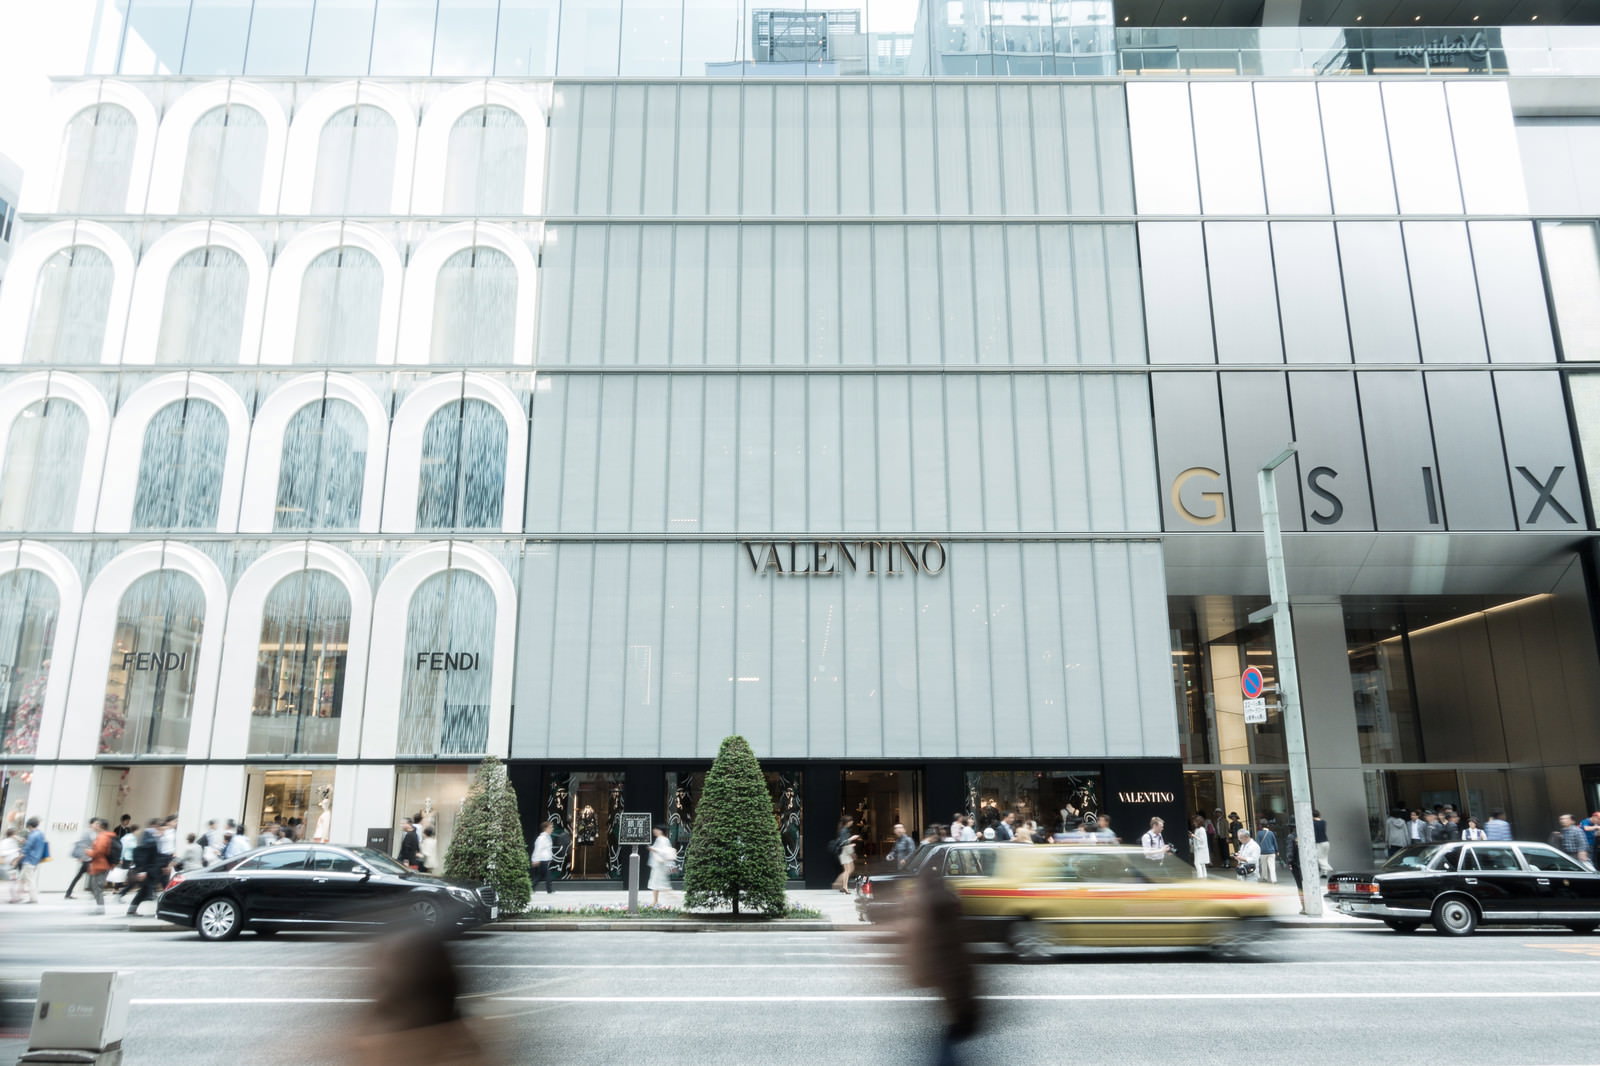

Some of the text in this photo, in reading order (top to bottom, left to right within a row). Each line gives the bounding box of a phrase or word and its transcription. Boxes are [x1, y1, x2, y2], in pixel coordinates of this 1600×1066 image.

[743, 541, 948, 577] VALENTINO
[122, 652, 187, 671] FENDI
[416, 652, 479, 671] FENDI
[1118, 791, 1175, 803] VALENTINO
